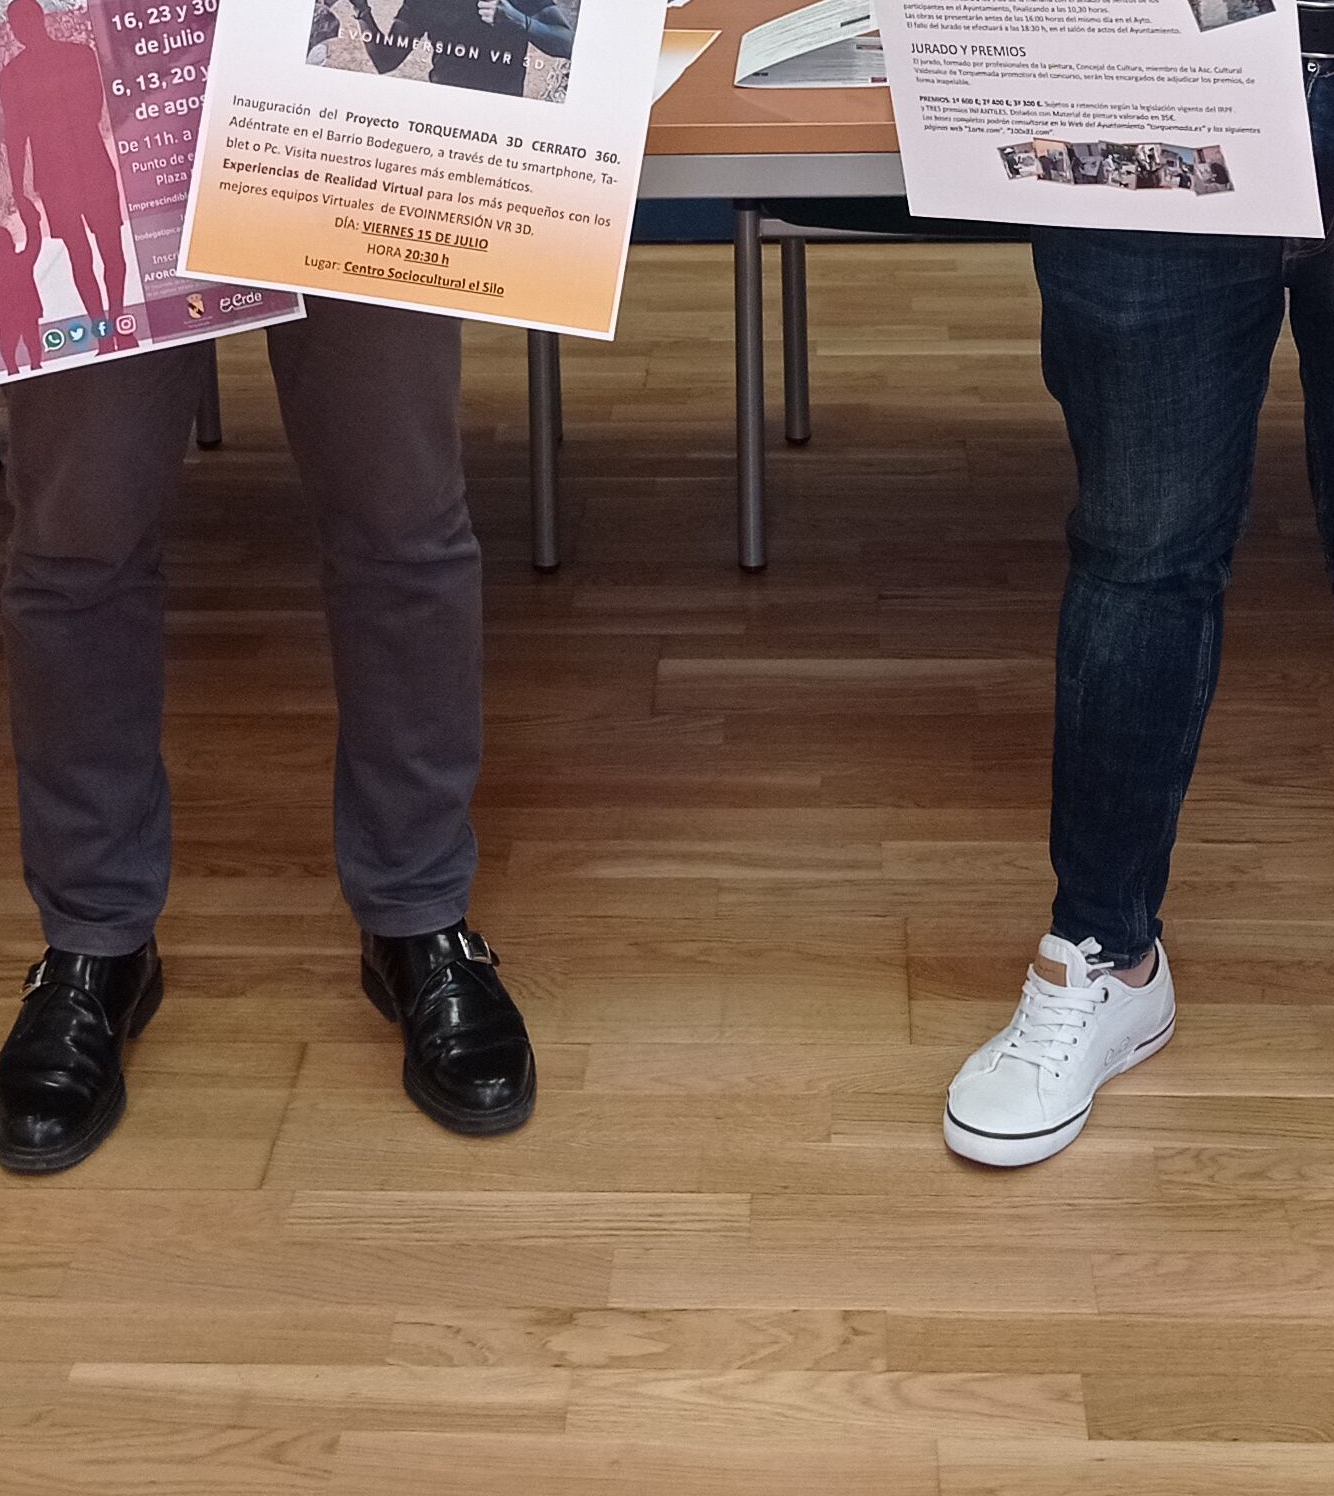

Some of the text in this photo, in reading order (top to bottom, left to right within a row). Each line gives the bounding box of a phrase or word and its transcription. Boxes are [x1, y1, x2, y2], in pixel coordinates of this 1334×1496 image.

[111, 11, 143, 30] 16,
[146, 5, 171, 24] 23
[175, 4, 187, 22] y
[134, 28, 205, 55] de julio
[337, 28, 546, 71] EVOINMERSION VR 3D
[911, 42, 1026, 57] JURADO Y PREMIOS
[112, 79, 131, 96] 6,
[136, 72, 167, 90] 13,
[170, 65, 196, 84] 20
[135, 92, 207, 119] de agos
[117, 130, 192, 154] De 11h. a
[232, 96, 620, 165] Inauguración del Proyecto TORQUEMADA 3D CERRATO 360.
[132, 153, 184, 172] Punto de
[228, 116, 617, 184] Adéntrate en el Barrio Bodeguero, a través de tu smartphone, Ta-
[155, 172, 187, 186] Plaza
[128, 192, 188, 211] Imprescindibl
[334, 215, 489, 249] DÍA: VIERNES 15 DE JULIO
[367, 243, 449, 265] HORA 20:30 h
[304, 255, 504, 295] Lugar: Centro Sociocultural el Silo
